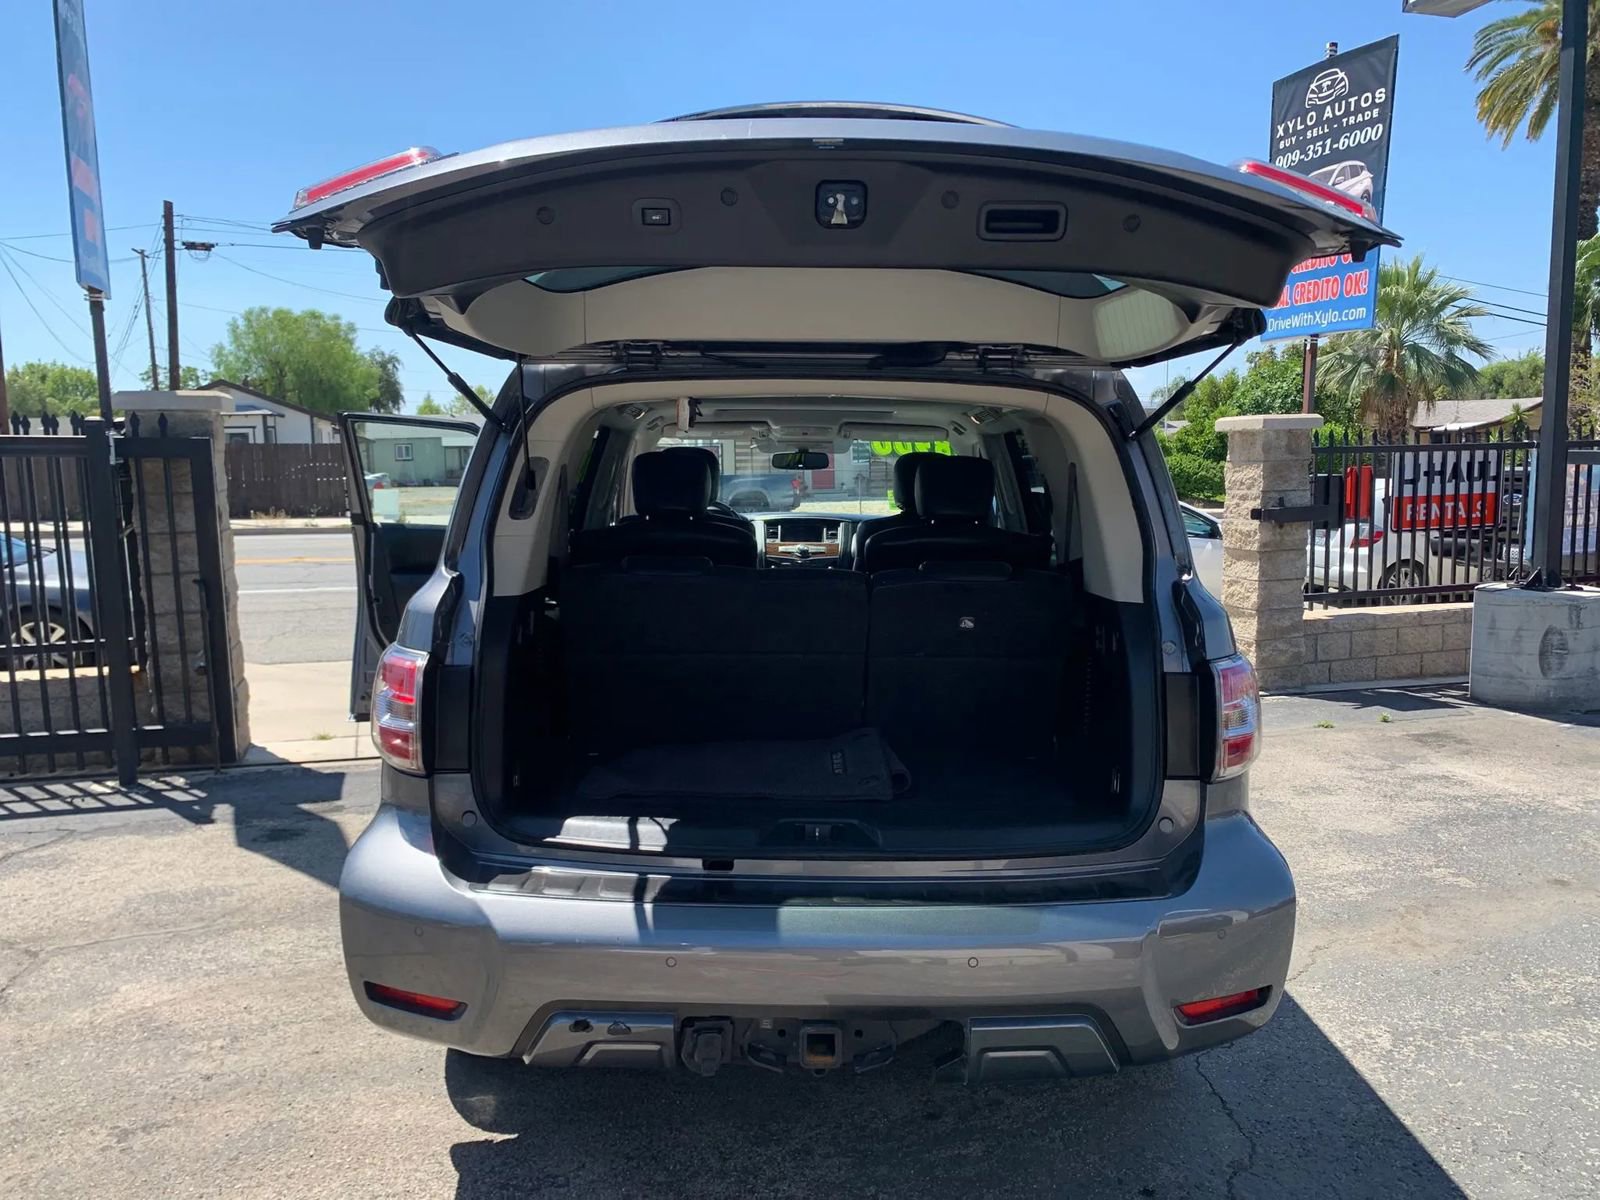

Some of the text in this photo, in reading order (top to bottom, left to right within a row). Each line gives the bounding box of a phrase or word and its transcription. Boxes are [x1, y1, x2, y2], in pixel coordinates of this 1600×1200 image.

[1276, 87, 1387, 139] XYLO AUTOS
[1279, 134, 1298, 150] BUY
[1306, 123, 1330, 140] SELL
[1341, 107, 1380, 128] TRADE
[1275, 123, 1384, 169] 909-351-6000
[1293, 274, 1341, 306] CREDITO
[1343, 268, 1369, 297] OK!
[1267, 306, 1367, 333] DriveWithXylo.com
